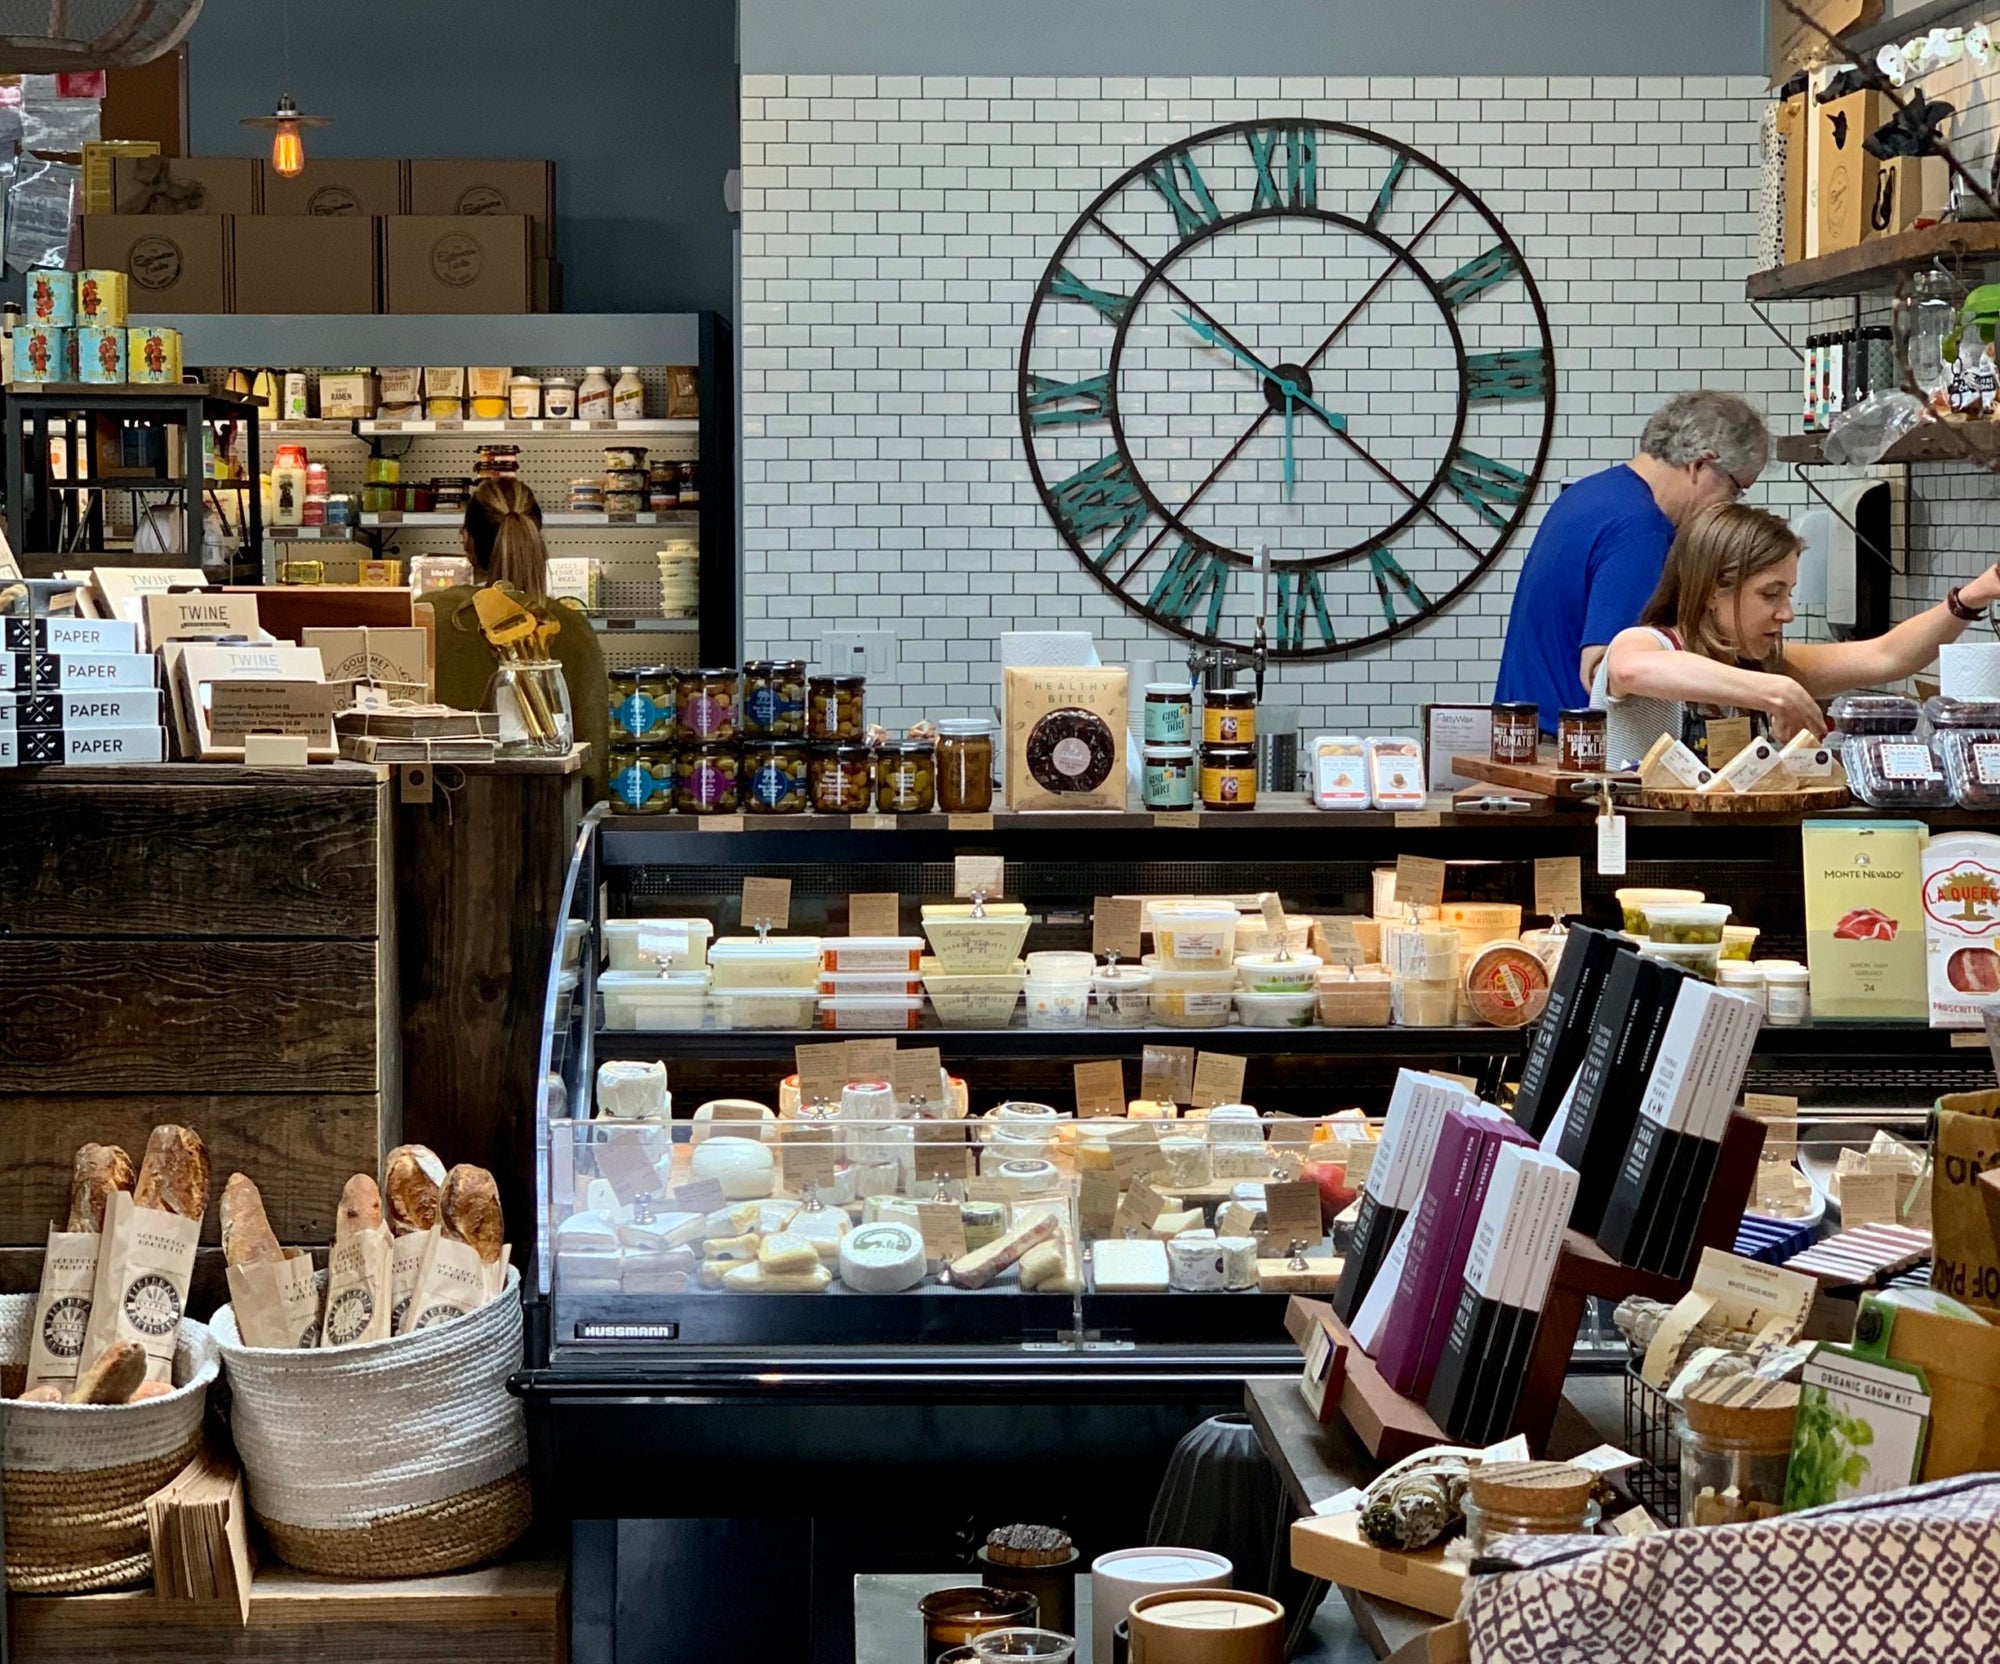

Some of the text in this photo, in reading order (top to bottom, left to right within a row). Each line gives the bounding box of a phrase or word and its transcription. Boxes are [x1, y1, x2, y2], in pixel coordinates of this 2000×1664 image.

[128, 574, 177, 585] TWINE
[178, 605, 229, 620] TWINE
[54, 629, 101, 643] PAPER
[227, 653, 280, 666] TWINE
[67, 665, 117, 678] PAPER
[1034, 682, 1108, 690] HEALTHY
[1048, 695, 1095, 703] BITES
[70, 703, 120, 717] PAPER
[72, 739, 123, 753] PAPER
[1824, 869, 1902, 879] MONTE NEVADO
[1927, 886, 1946, 905] LA
[1863, 984, 1875, 992] 24
[1933, 1002, 1983, 1014] PROSCIUTTO
[585, 1326, 669, 1337] HUSSMANN
[1821, 1372, 1912, 1406] ORGANIC GROW KIT
